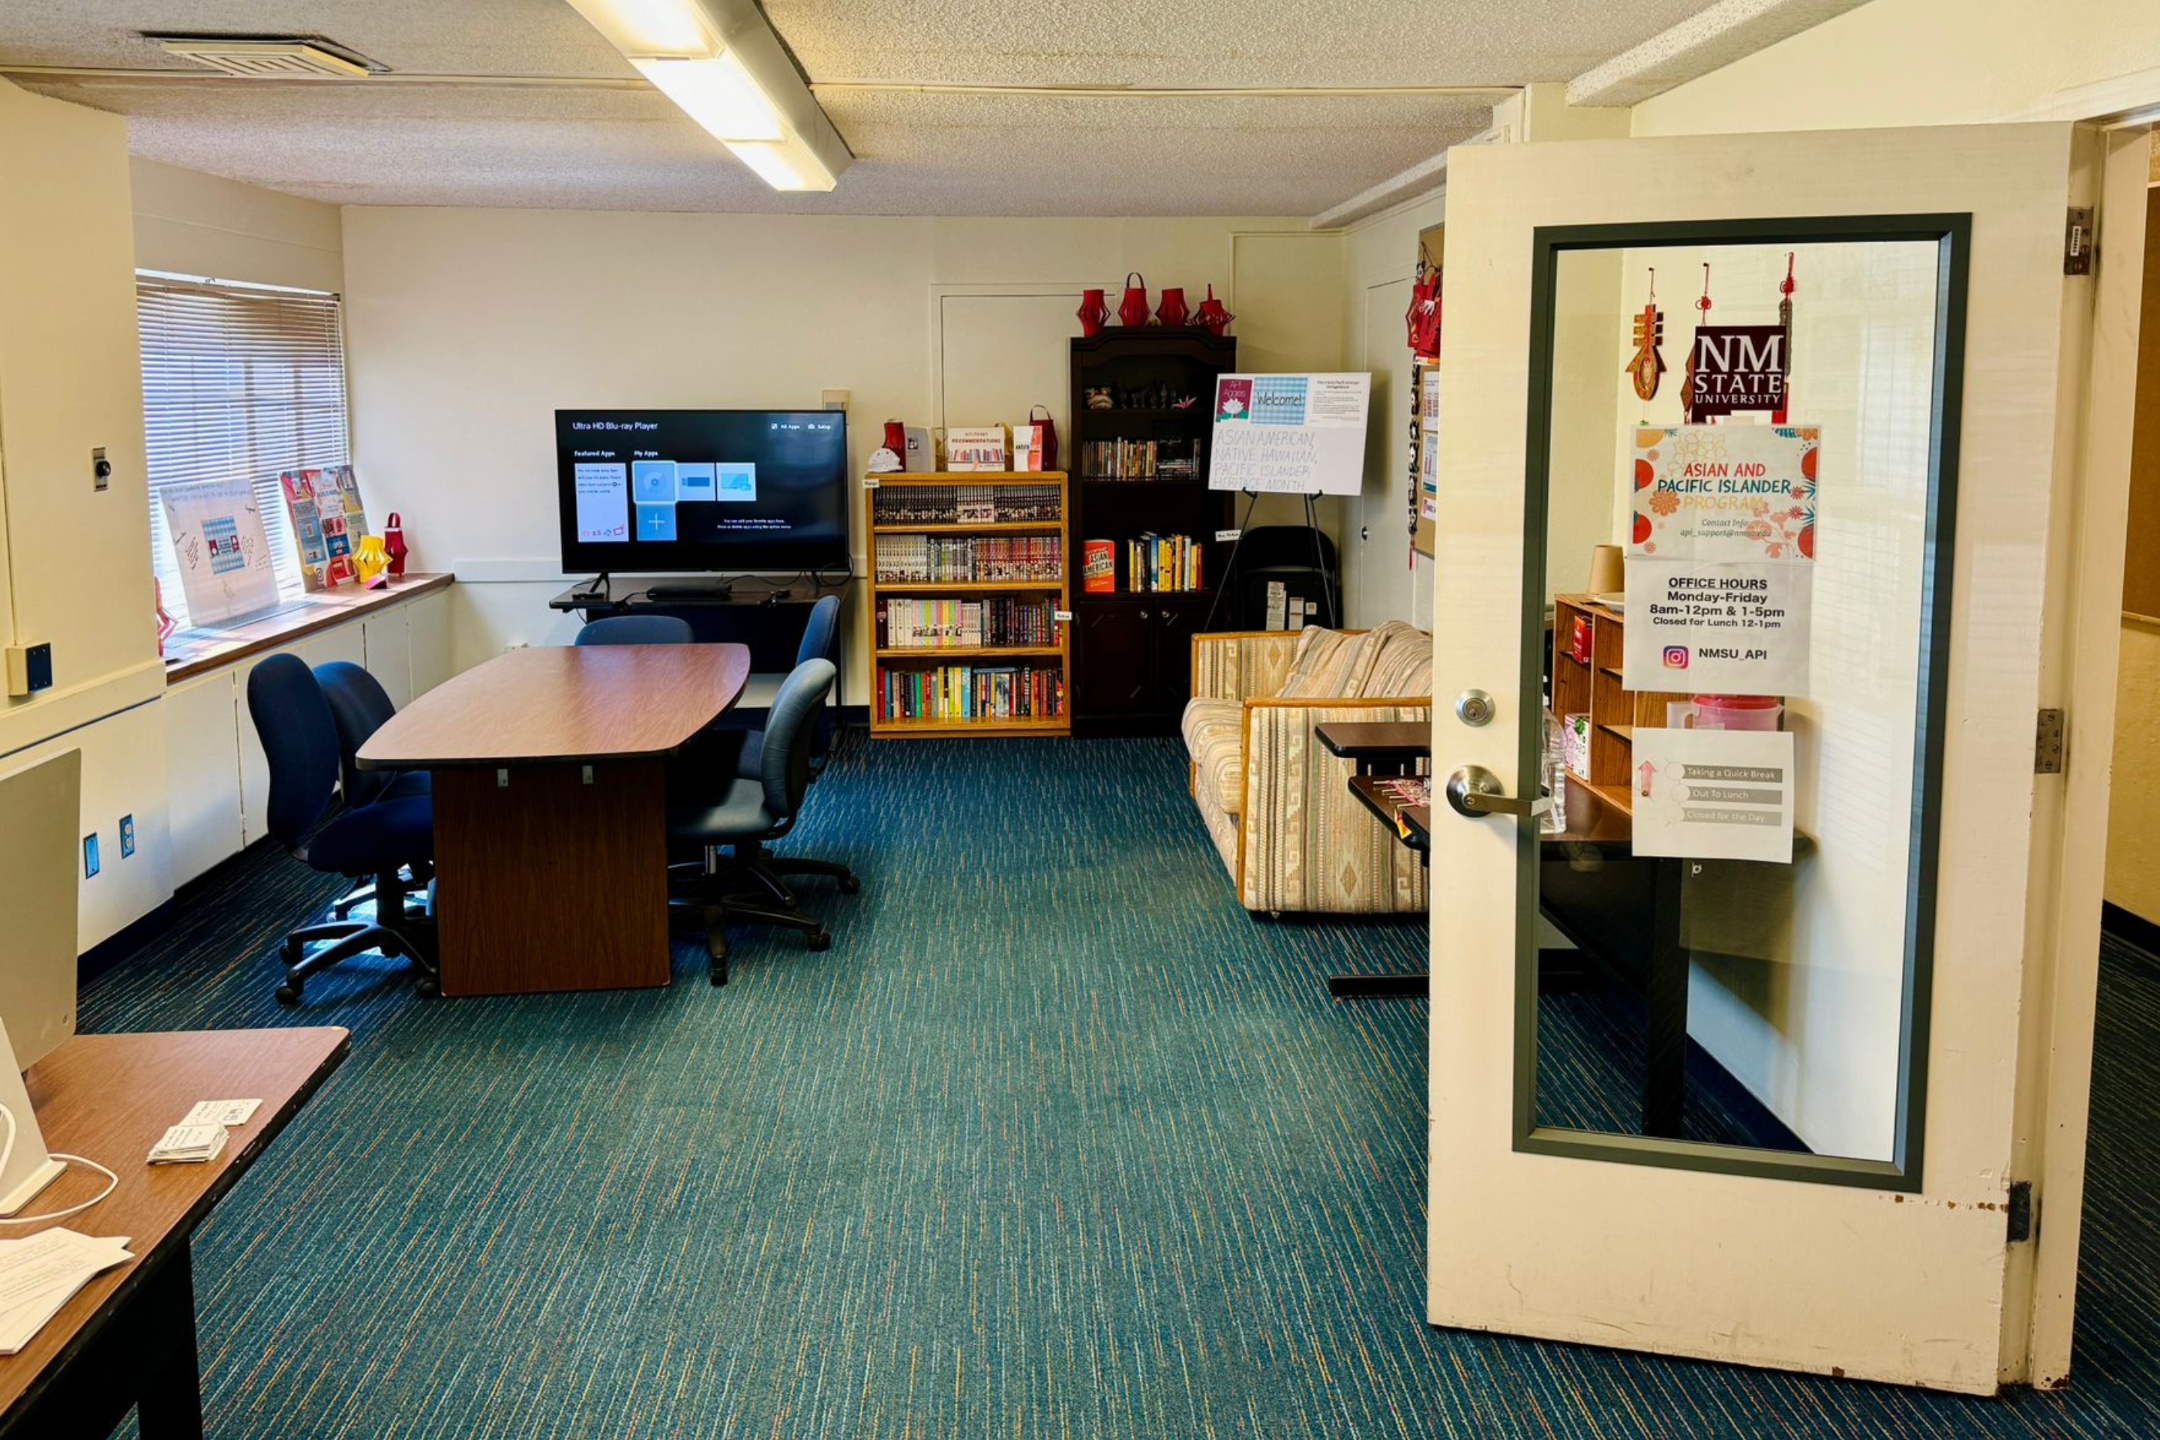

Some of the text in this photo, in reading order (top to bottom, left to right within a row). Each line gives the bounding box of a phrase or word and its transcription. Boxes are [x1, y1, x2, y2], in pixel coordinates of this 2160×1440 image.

[1695, 334, 1784, 373] NM
[1694, 373, 1782, 394] STATE
[1257, 391, 1302, 406] Welcome!
[1694, 394, 1781, 404] UNIVERSITY
[572, 421, 658, 432] Ultra HD Blu-ray Player
[1215, 429, 1255, 446] ASIAN
[600, 450, 615, 458] Apps
[633, 450, 643, 458] My
[1214, 447, 1255, 462] NATIVE
[1214, 462, 1257, 476] PACIFIC
[1684, 463, 1766, 477] ASIAN AND
[1264, 479, 1305, 490] MONTH
[1657, 479, 1791, 494] PACIFIC ISLANDER
[1683, 495, 1763, 510] PROGRAM
[1701, 518, 1731, 527] Contact
[1089, 551, 1109, 563] ASIAN
[1083, 560, 1114, 575] AMERICAN
[1668, 577, 1768, 590] OFFICE HOURS
[1667, 591, 1768, 605] Monday-Friday
[1649, 603, 1785, 618] 8am-12pm & 1-5pm
[1652, 616, 1781, 629] Closed for Lunch 12-1pm
[1698, 648, 1767, 660] NMSU_API
[1687, 767, 1715, 778] Taking
[1723, 769, 1749, 778] Quick
[1751, 770, 1775, 779] Break
[1692, 789, 1749, 799] Out To Lunch
[1687, 810, 1766, 823] Closed for the Day
